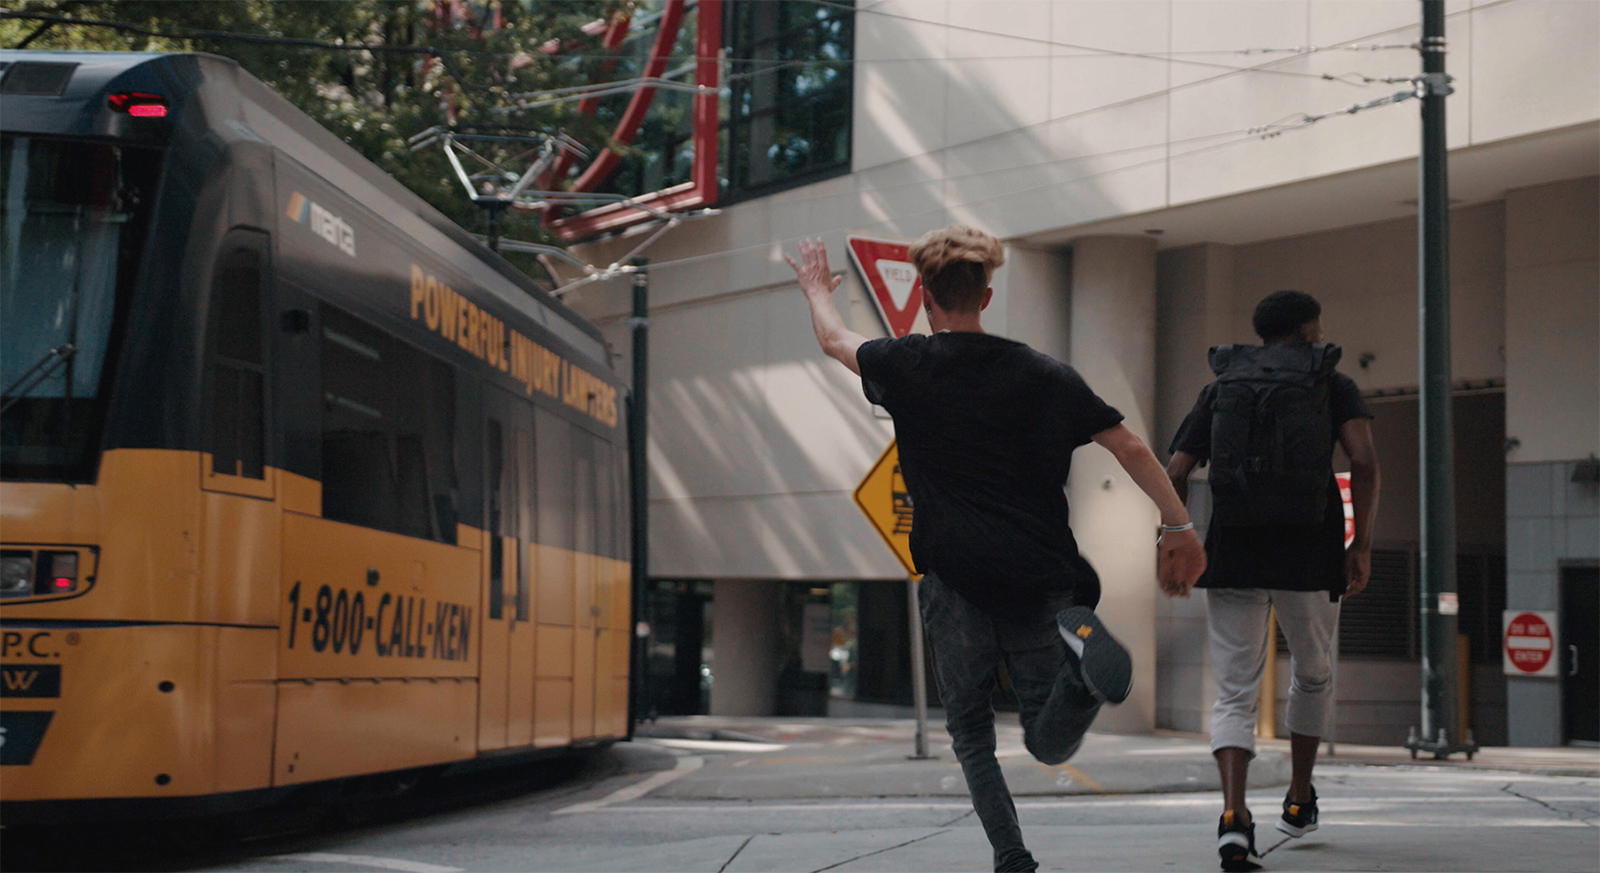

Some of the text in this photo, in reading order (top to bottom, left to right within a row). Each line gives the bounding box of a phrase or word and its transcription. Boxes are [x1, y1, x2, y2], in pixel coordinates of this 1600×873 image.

[310, 201, 356, 257] marta
[885, 268, 912, 282] YIELD
[410, 263, 508, 373] POWERFUL
[510, 328, 561, 396] INJURY
[288, 580, 472, 661] 1-800-CALL-KEN
[1510, 623, 1547, 636] DO NOT
[1514, 650, 1544, 663] ENTER
